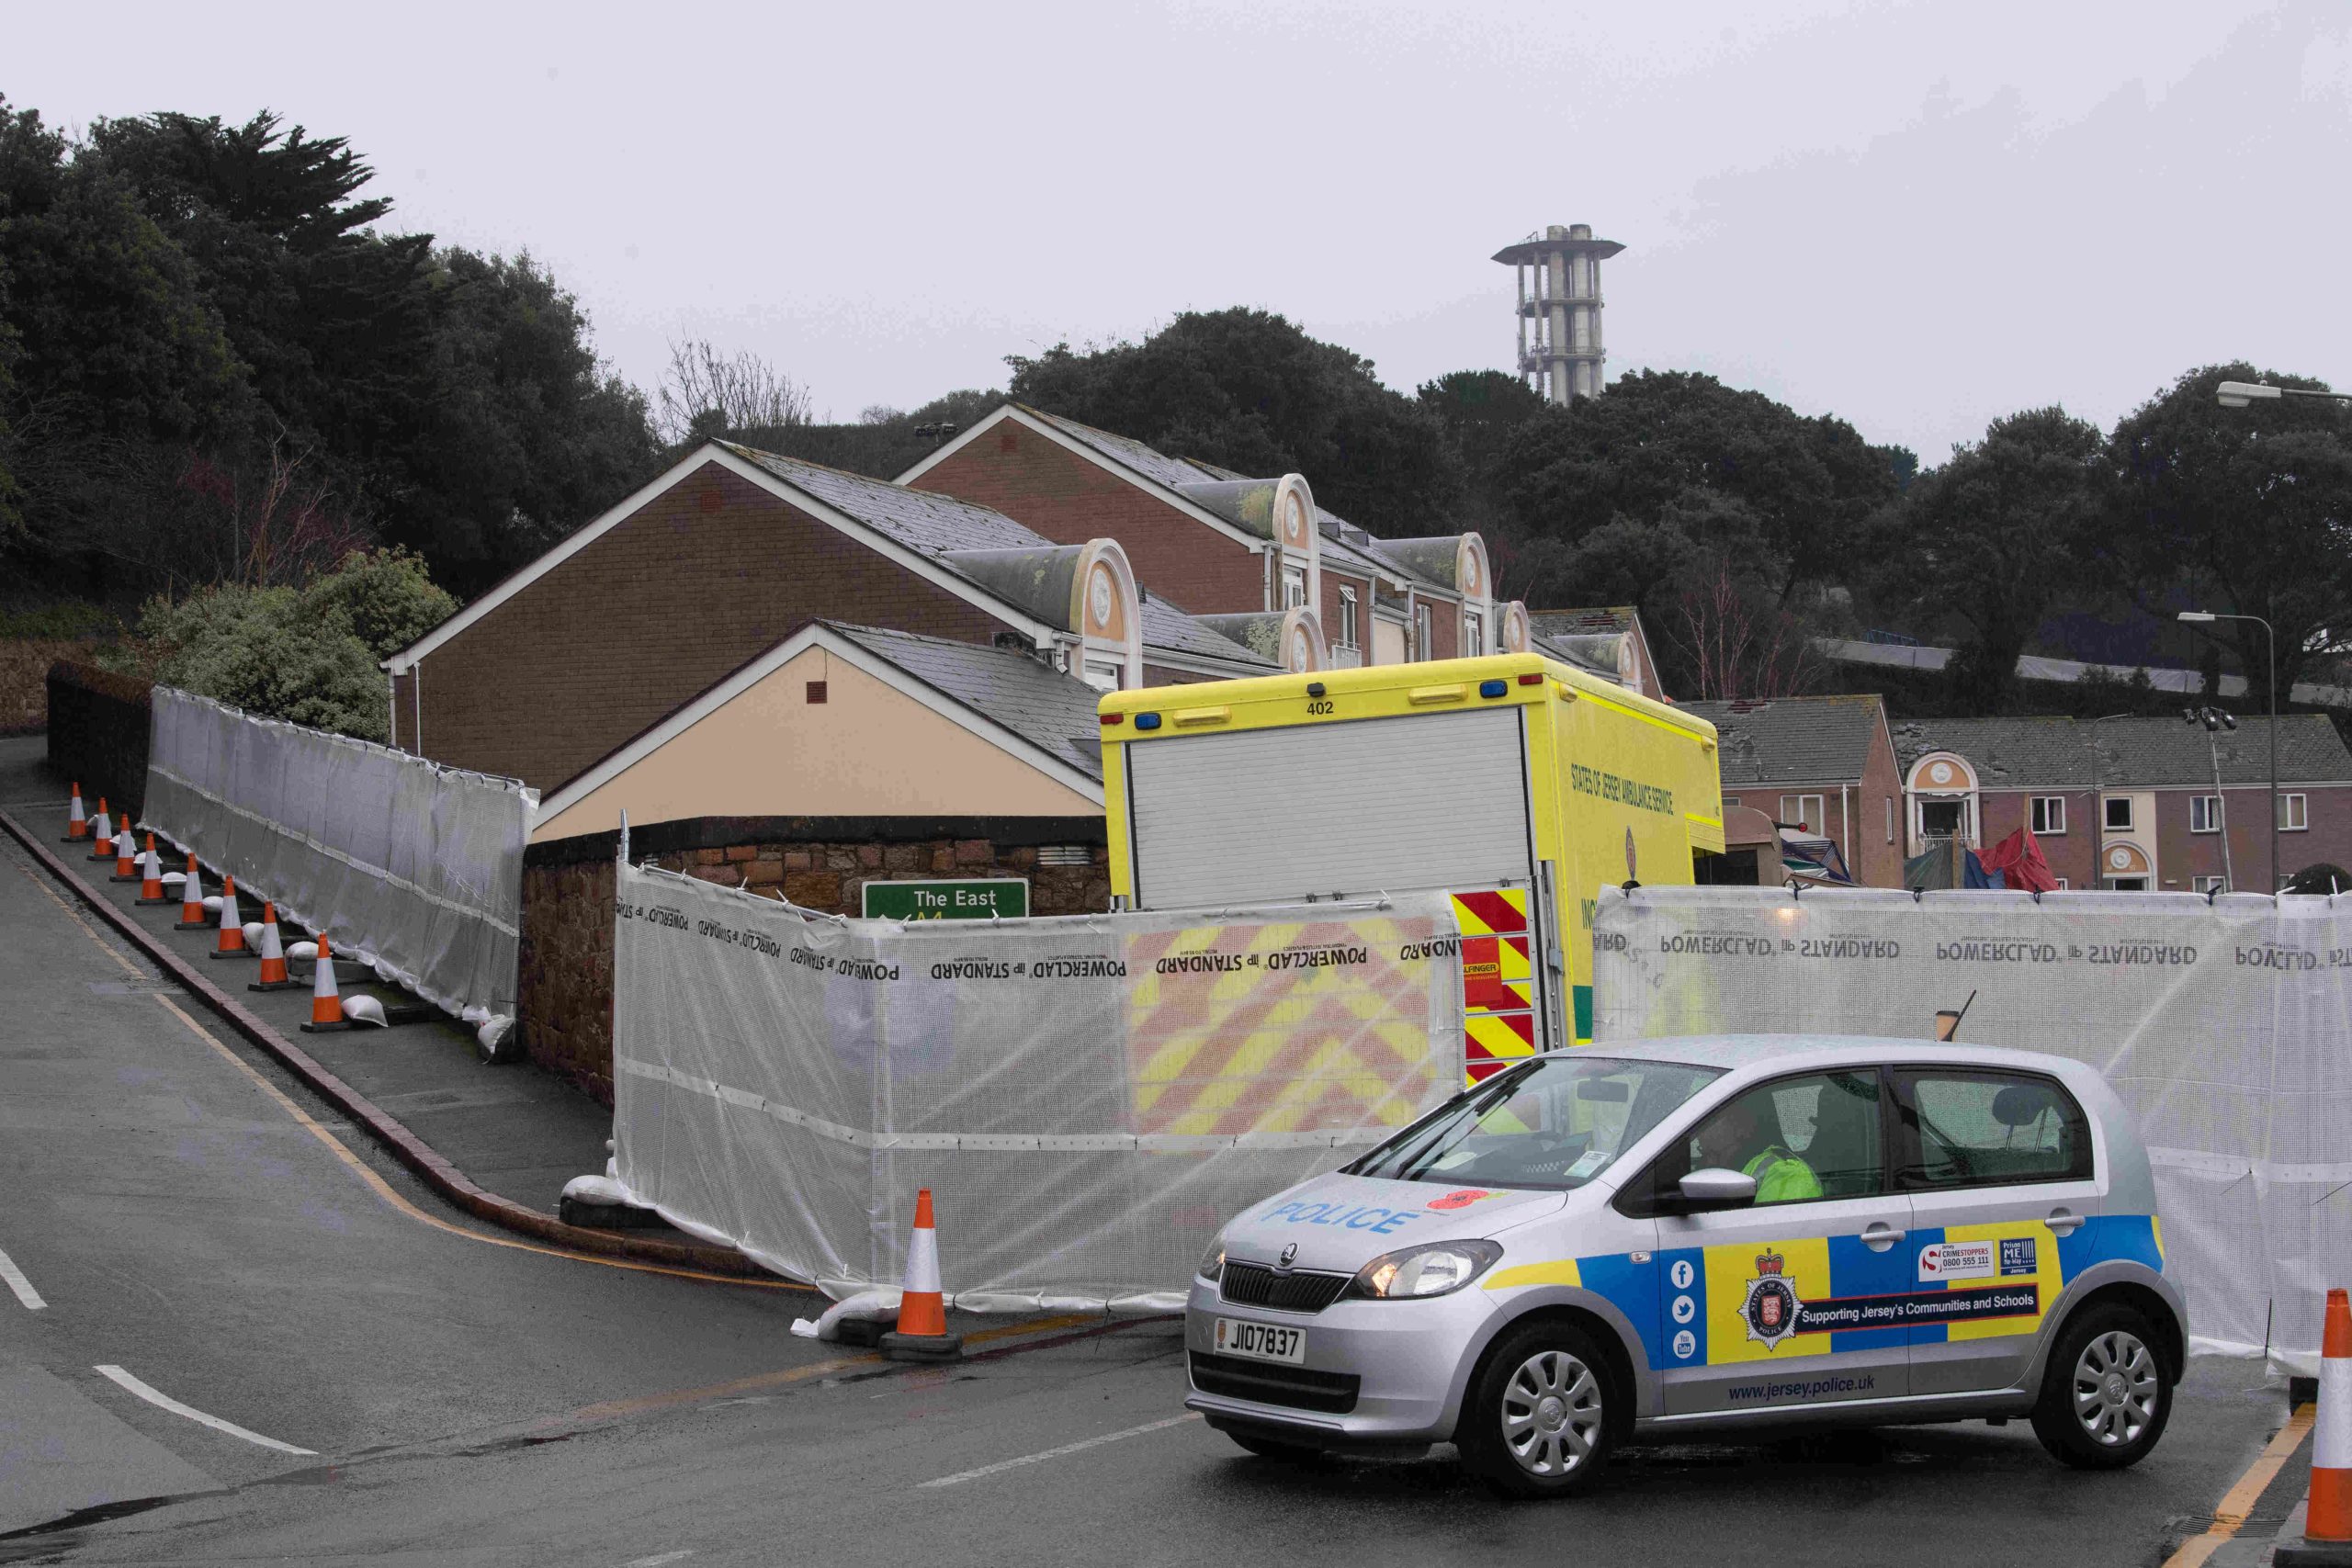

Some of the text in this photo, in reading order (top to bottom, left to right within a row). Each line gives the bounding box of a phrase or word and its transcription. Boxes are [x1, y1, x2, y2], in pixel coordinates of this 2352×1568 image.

[1306, 701, 1334, 716] 402
[1571, 762, 1592, 795] STATES
[1592, 770, 1600, 796] OF
[1601, 773, 1621, 802] JERSEY
[913, 889, 997, 907] The East
[931, 963, 1010, 979] STANDARD
[1156, 954, 1242, 974] STANDARD
[1463, 964, 1497, 974] LFINGER
[1260, 1201, 1421, 1235] POLICE
[1942, 1248, 1989, 1258] CRIMESTOPPERS
[1942, 1256, 1989, 1267] 0800 555 111
[2004, 1248, 2021, 1258] ME
[1802, 1306, 1860, 1325] Supporting
[1905, 1299, 1971, 1315] Communities
[1973, 1297, 1992, 1310] and
[1993, 1292, 2034, 1307] Schools
[1728, 1374, 1875, 1402] www.jersey.police.uk
